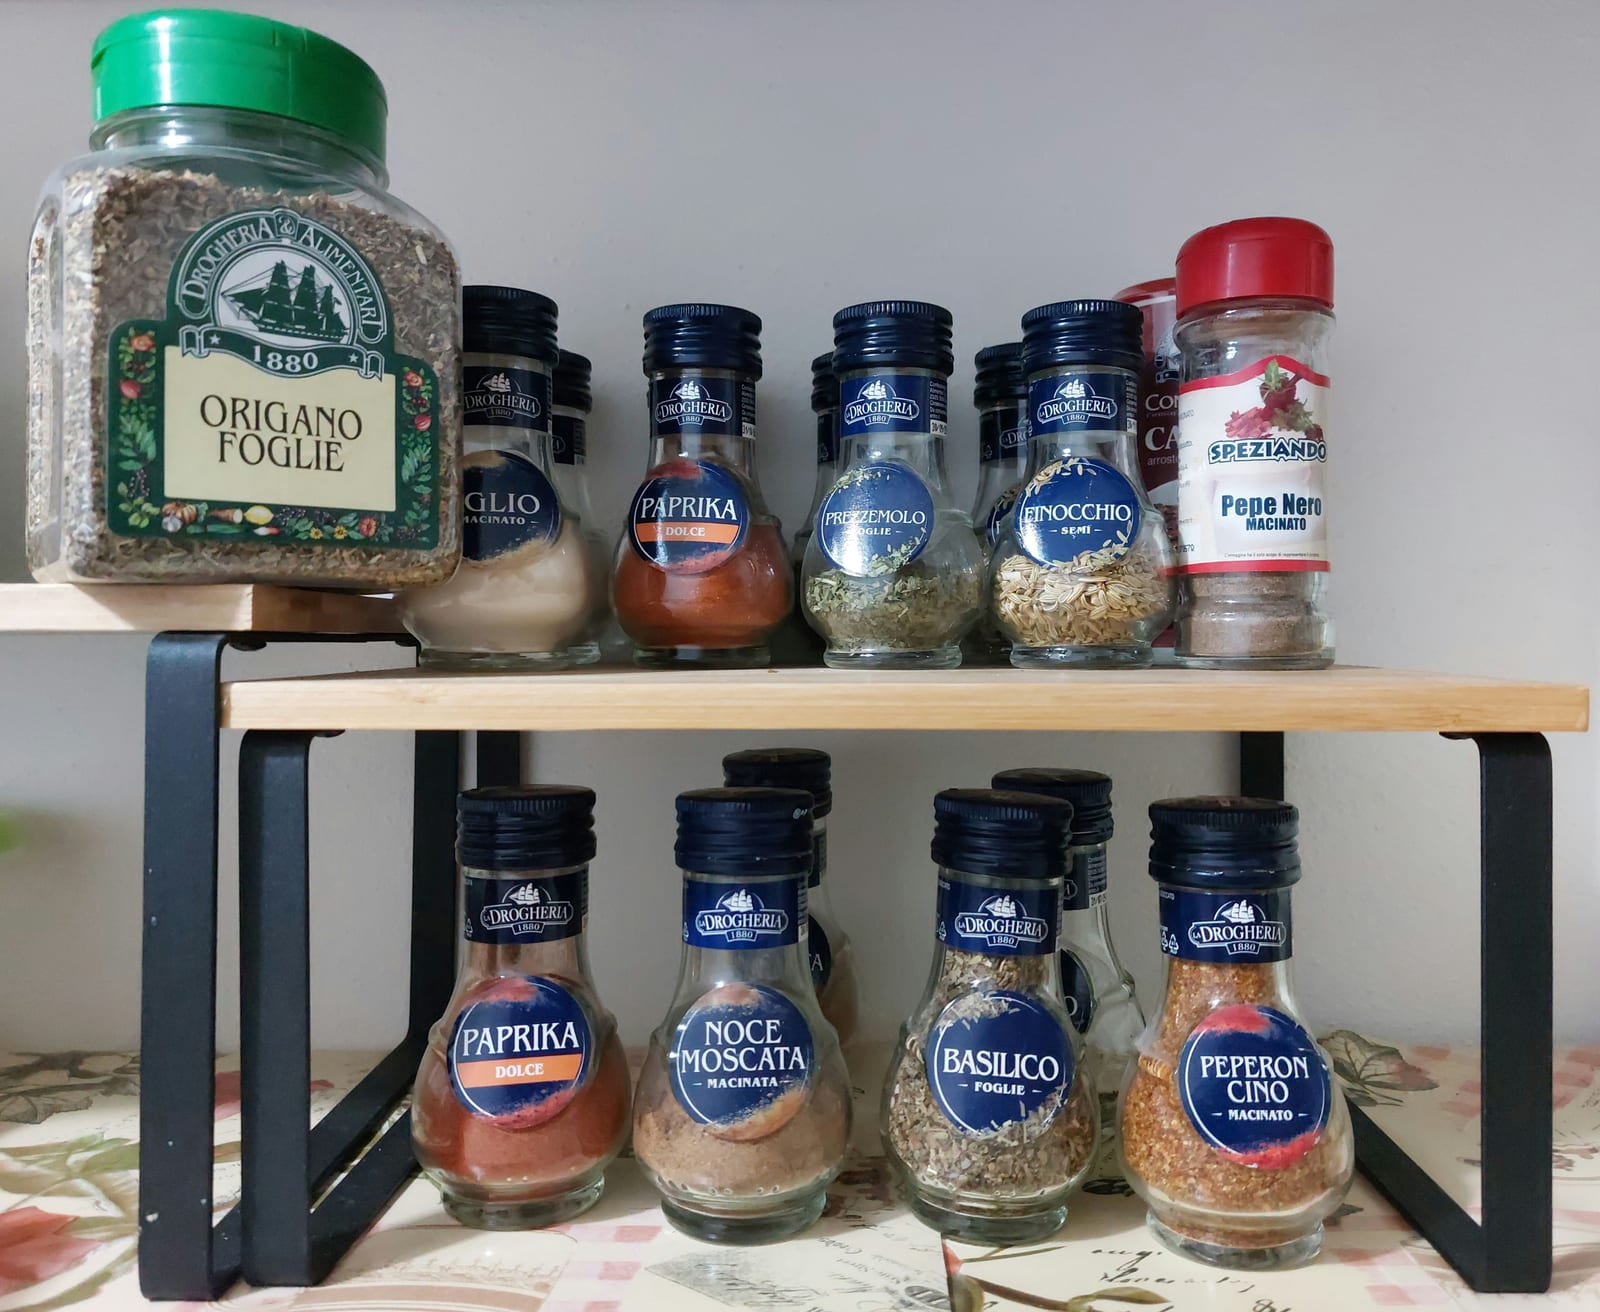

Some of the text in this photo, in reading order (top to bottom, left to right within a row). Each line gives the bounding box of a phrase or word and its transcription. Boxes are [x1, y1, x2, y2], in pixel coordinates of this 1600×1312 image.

[183, 214, 378, 335] DROGHERIA & ALIMENTARI
[254, 346, 319, 373] 1880
[464, 393, 536, 413] DROGHERIA
[660, 401, 726, 418] DROGHERIA
[849, 401, 913, 419] DROGHERIA
[1043, 400, 1111, 418] DROGHERIA
[200, 394, 363, 440] ORIGANO
[218, 431, 345, 472] FOGLIE
[1209, 438, 1327, 462] SPEZIANDO
[464, 491, 540, 515] GLIO
[640, 497, 738, 520] PAPRIKA
[1024, 503, 1132, 522] FINOCCHIO
[1221, 492, 1322, 518] Pepe Nero
[825, 509, 926, 526] PREZZEMOLO
[1246, 517, 1306, 531] MACINATO
[665, 527, 706, 537] DOLCE
[855, 527, 892, 536] OGLIE
[1061, 525, 1092, 535] SEMI
[489, 904, 569, 925] DROGHERIA
[703, 913, 783, 931] DROGHERIA
[518, 922, 541, 932] 1880
[730, 930, 753, 939] 1880
[965, 916, 1043, 937] DROGHERIA
[1199, 924, 1282, 943] DROGHERIA
[992, 935, 1015, 945] 1880
[1232, 941, 1256, 951] 1880
[462, 1021, 580, 1057] PAPRIKA
[704, 1019, 782, 1046] NOCE
[681, 1046, 806, 1074] MOSCATA
[943, 1048, 1059, 1081] BASILICO
[1200, 1055, 1310, 1080] PEPERON
[495, 1063, 545, 1079] DOLCE
[707, 1076, 779, 1089] MACINATA
[974, 1081, 1025, 1096] FOGLIE
[1227, 1080, 1290, 1103] CINO
[1228, 1109, 1293, 1121] MACINATO
